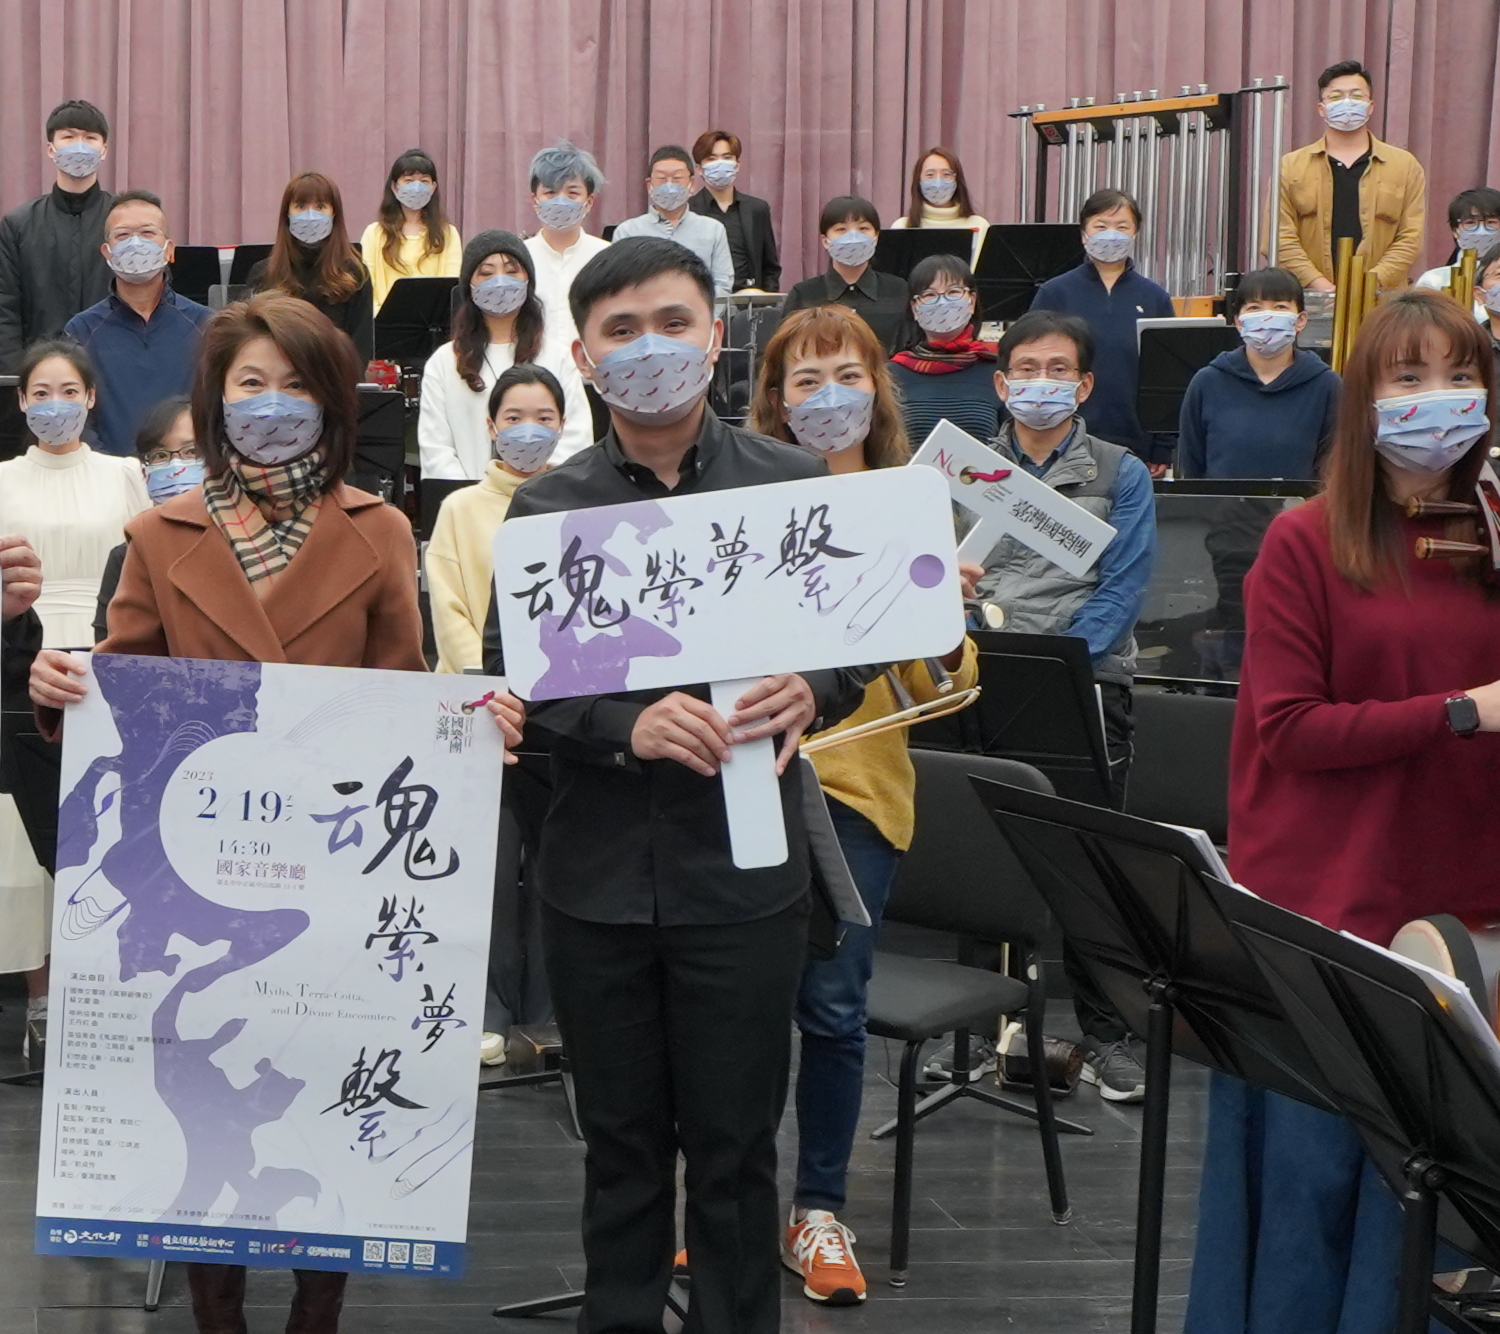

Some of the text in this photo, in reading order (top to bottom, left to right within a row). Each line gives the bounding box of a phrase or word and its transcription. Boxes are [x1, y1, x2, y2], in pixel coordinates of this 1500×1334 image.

[1008, 498, 1093, 559] 臺灣國樂團
[182, 770, 214, 781] 2023
[219, 839, 271, 856] 14:30
[216, 859, 306, 880] 國家音樂廳
[271, 1001, 397, 1022] and Divine Encounters
